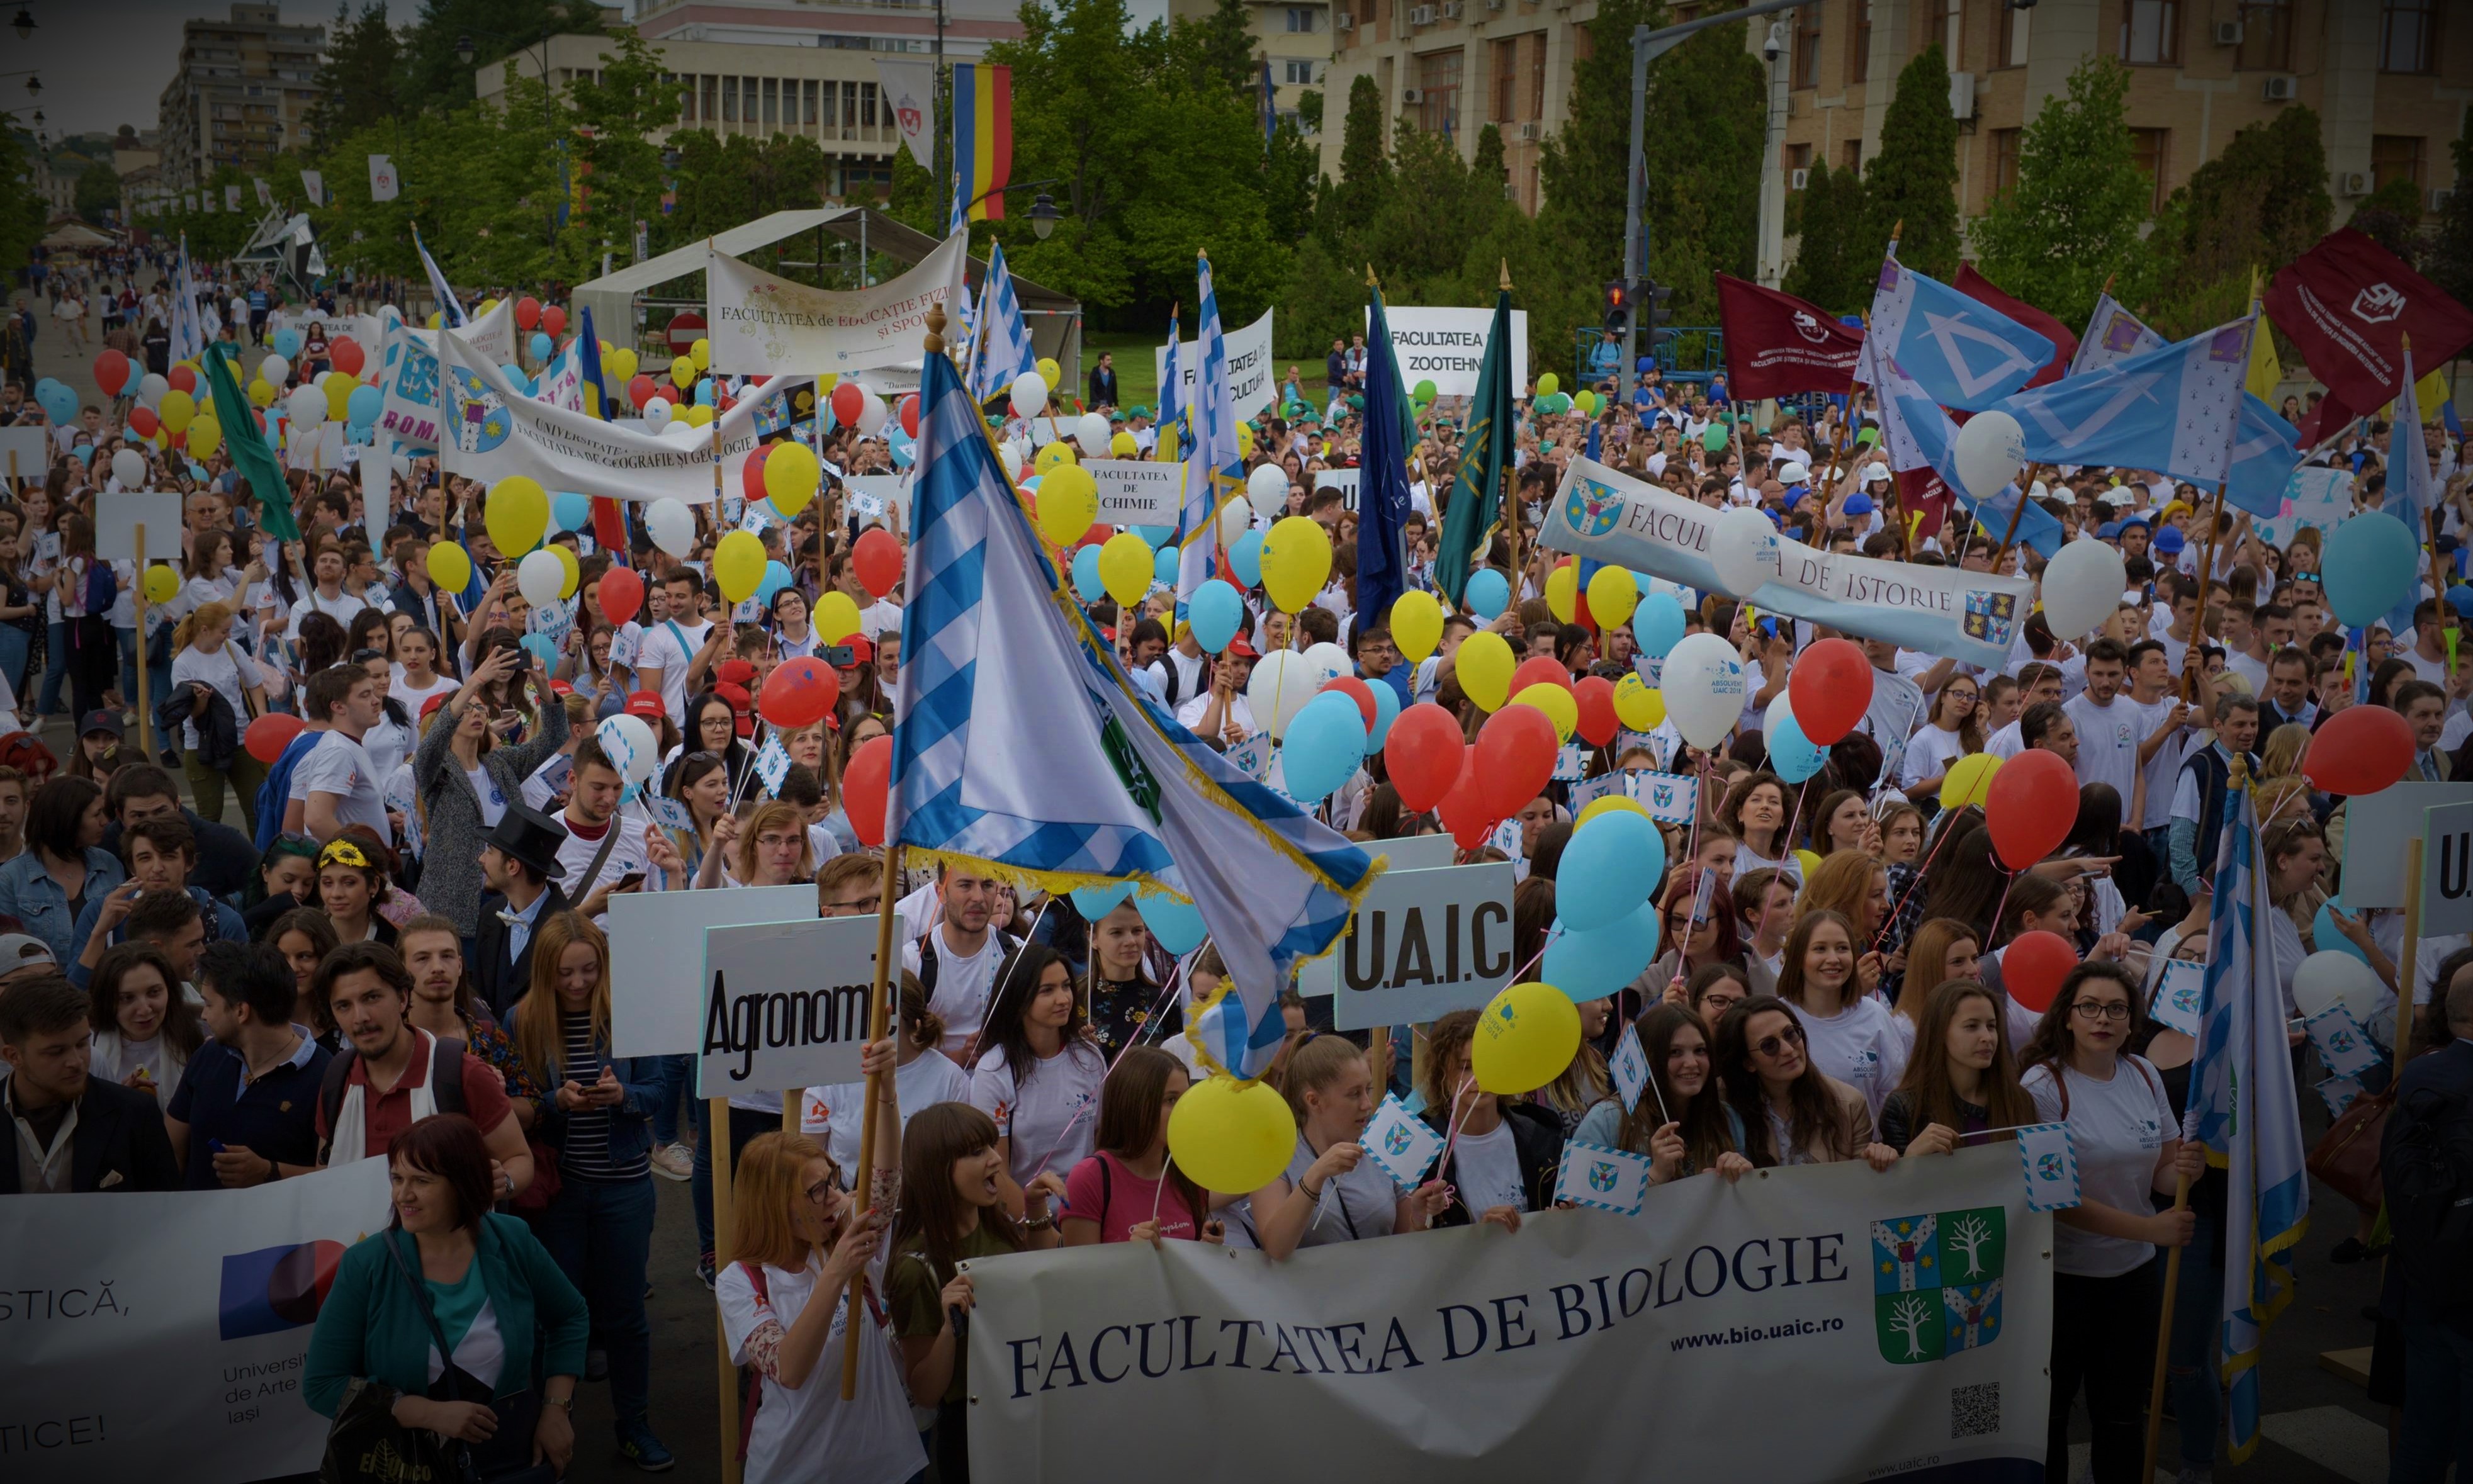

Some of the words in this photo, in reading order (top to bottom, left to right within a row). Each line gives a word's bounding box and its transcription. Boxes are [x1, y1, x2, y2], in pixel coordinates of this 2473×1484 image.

[721, 306, 814, 327] FACULTATEA
[818, 314, 834, 327] de
[838, 299, 916, 327] EDUCAȚIE
[877, 322, 889, 340] și
[1391, 331, 1483, 347] FACULTATEA
[1409, 356, 1484, 371] ZOOTEHN
[2356, 352, 2392, 388] MATERIALELOR
[516, 423, 583, 458] FACULTATEA
[602, 451, 675, 469] GEOGRAFIE
[677, 453, 689, 469] ȘI
[1094, 469, 1168, 481] FACULTATEA
[1123, 484, 1138, 493] DE
[1101, 497, 1158, 510] CHIMIE
[1798, 559, 1831, 592] DE
[1845, 573, 1951, 612] ISTORIE
[1344, 901, 1511, 991] U.A.I.C
[1006, 1315, 1424, 1399] FACULTATEA
[1437, 1294, 1536, 1361] DE
[1550, 1233, 1849, 1341] BIOLOGIE
[1670, 1315, 1844, 1352] www.bio.uaic.ro
[223, 1352, 307, 1383] Universit
[225, 1387, 252, 1404] de
[257, 1377, 297, 1398] Arte
[228, 1405, 260, 1425] Iași
[1867, 1455, 1940, 1478] www.uaic.ro
